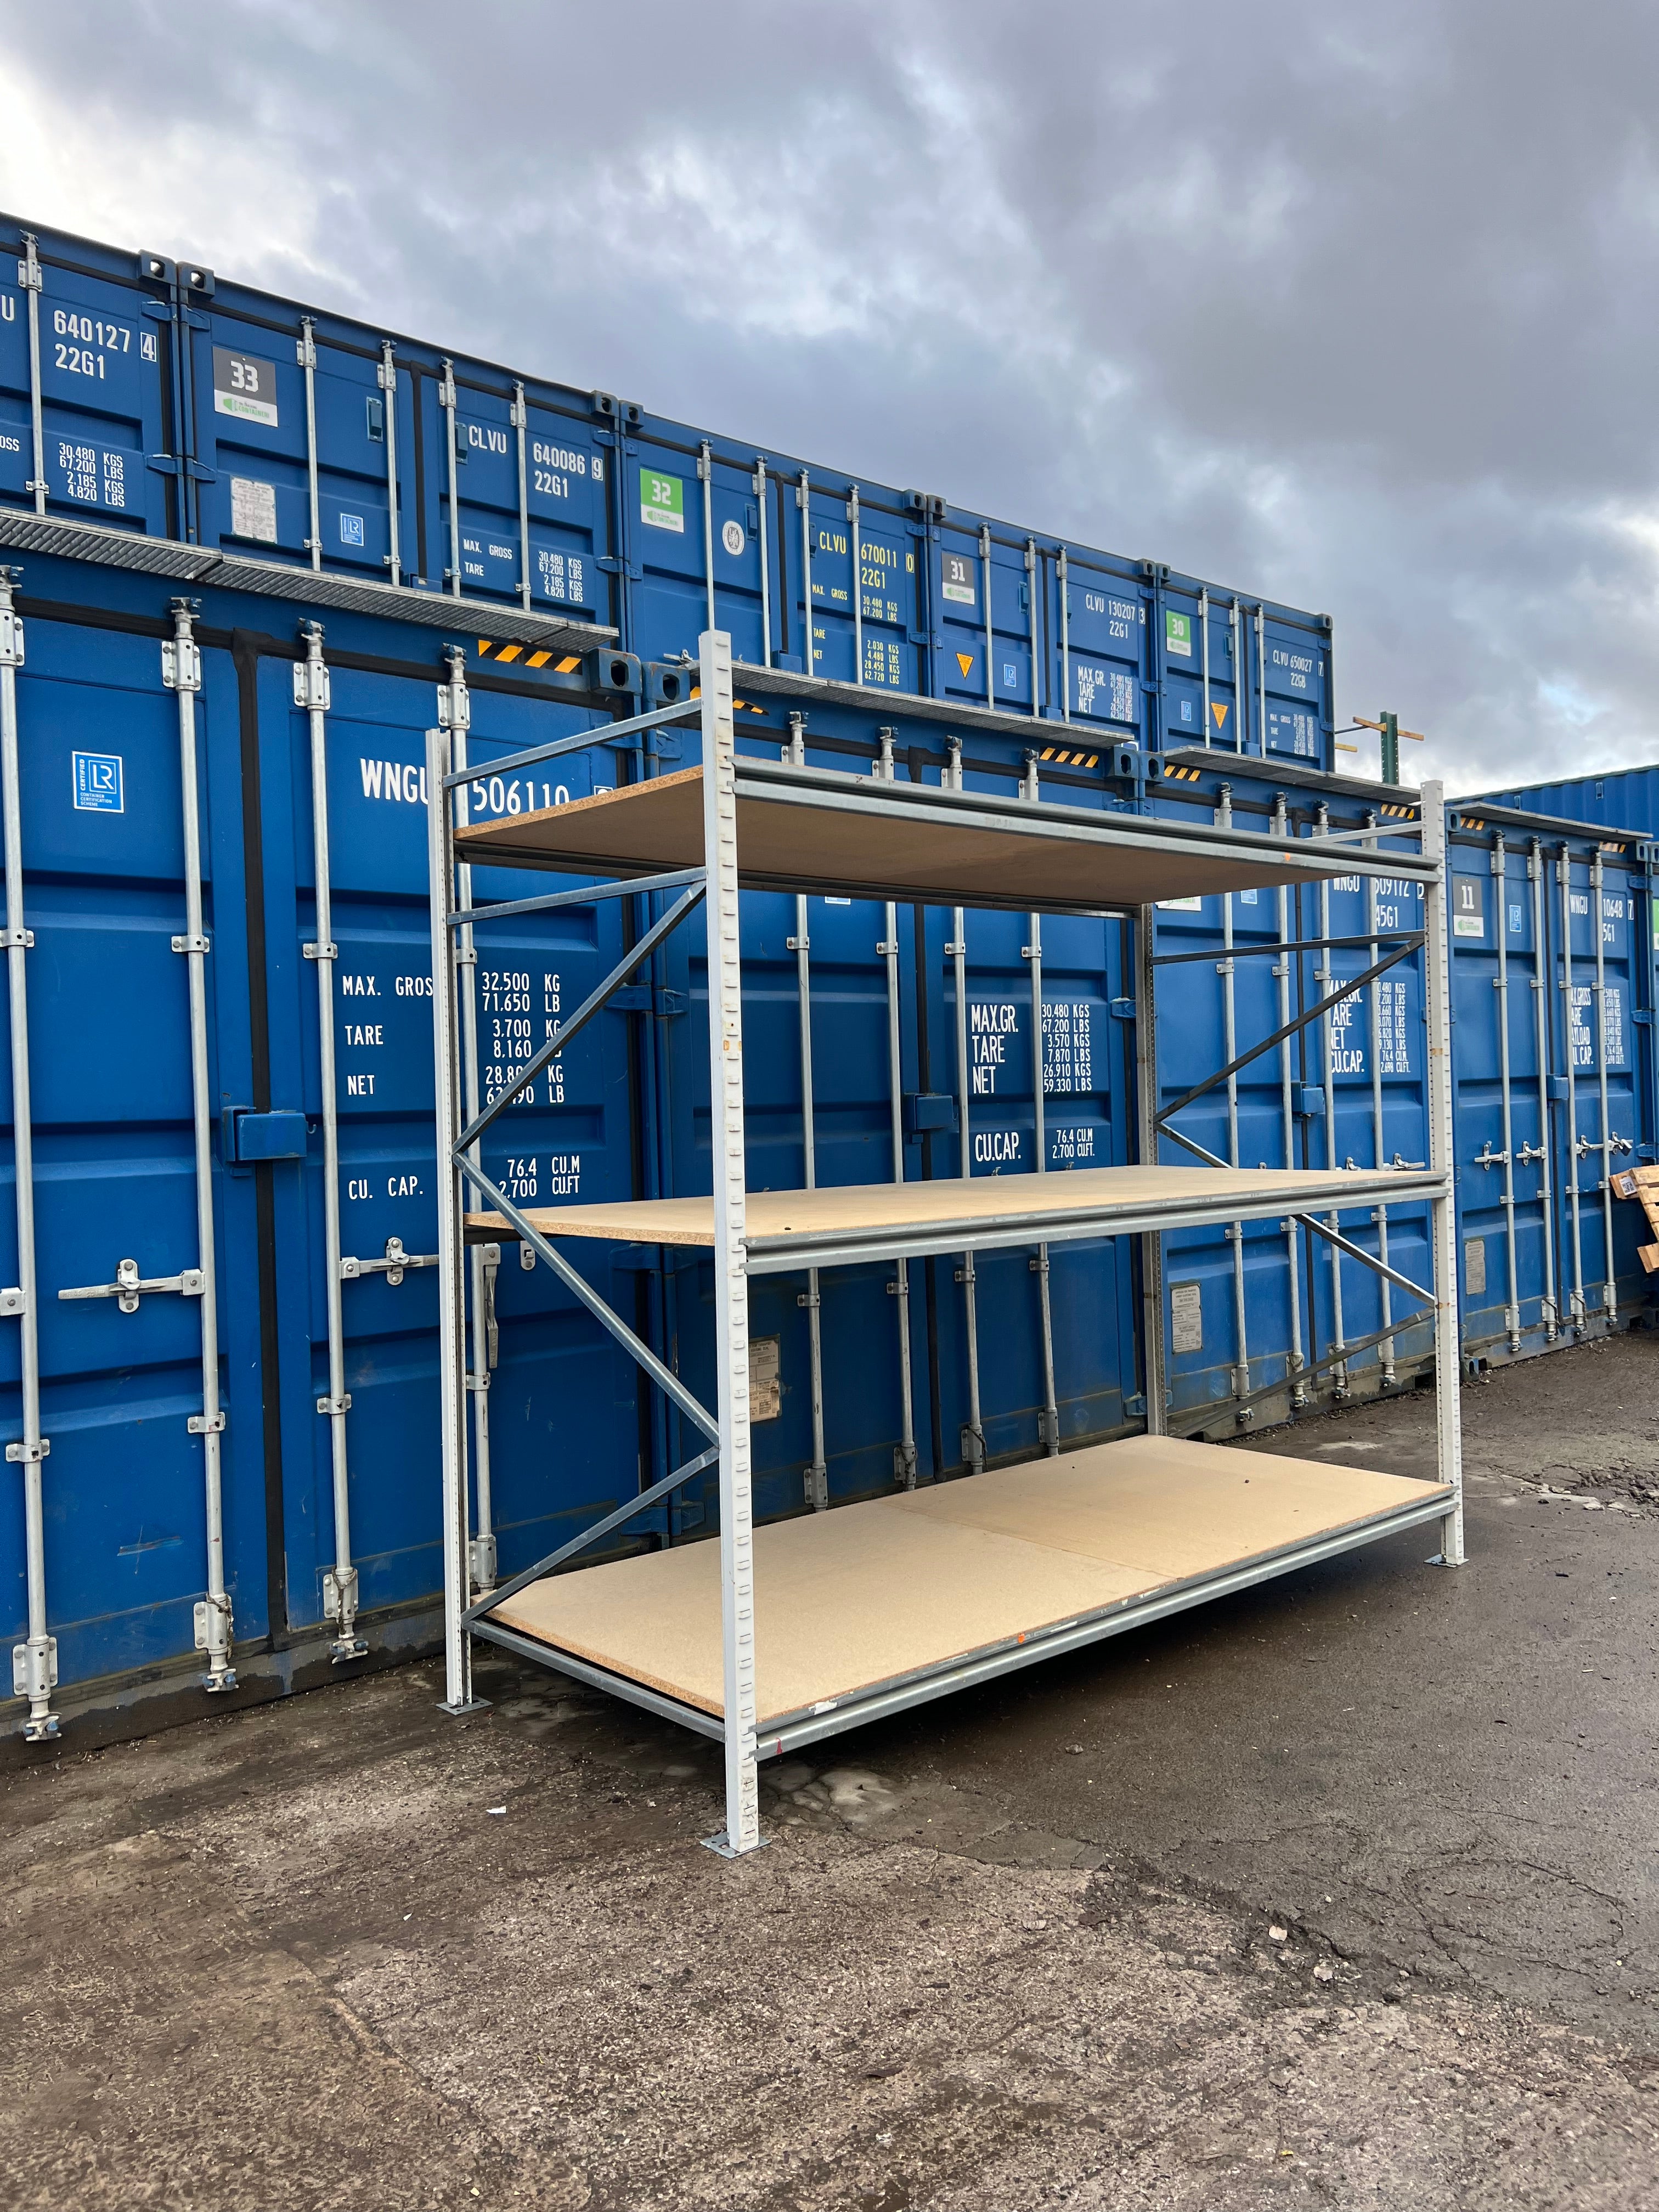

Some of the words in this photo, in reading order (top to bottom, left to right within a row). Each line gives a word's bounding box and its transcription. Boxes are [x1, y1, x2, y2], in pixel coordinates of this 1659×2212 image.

[54, 310, 130, 353] 640127
[142, 334, 155, 360] 4
[55, 343, 104, 379] 22G1
[230, 360, 258, 392] 33
[469, 426, 507, 454] CLVU
[59, 442, 95, 462] 30.480
[103, 452, 123, 468] KGS
[533, 443, 585, 475] 640086
[592, 458, 602, 479] 9
[59, 455, 96, 475] 67.200
[104, 465, 123, 480] LBS
[67, 471, 96, 489] 2.185
[104, 479, 124, 494] KGS
[534, 470, 568, 498] 22G1
[652, 479, 671, 505] 32
[67, 484, 97, 501] 4.820
[105, 492, 125, 507] LBS
[463, 539, 482, 553] MAX.
[489, 545, 512, 560] GROSS
[820, 532, 846, 554] CLVU
[539, 551, 563, 566] 30.480
[568, 557, 582, 570] KGS
[861, 543, 896, 568] 670011
[906, 554, 913, 572] 0
[465, 561, 484, 576] TARE
[539, 561, 564, 576] 67.200
[568, 568, 582, 580] LBS
[861, 567, 885, 589] 22G1
[951, 560, 965, 582] 31
[544, 574, 564, 588] 2.185
[569, 579, 583, 592] KGS
[812, 584, 825, 595] MAX.
[831, 588, 848, 600] GROSS
[544, 584, 565, 599] 4.820
[569, 590, 583, 602] LBS
[863, 595, 882, 608] 30.480
[887, 601, 898, 612] KGS
[1086, 594, 1104, 613] CLVU
[1109, 600, 1135, 621] 130207
[1139, 608, 1145, 624] 3
[863, 606, 882, 619] 67.200
[888, 612, 896, 622] LBS
[813, 628, 825, 639] TARE
[1109, 620, 1127, 639] 22G1
[1172, 618, 1184, 636] 30
[813, 649, 822, 659] NET
[867, 640, 883, 651] 2.030
[888, 644, 899, 654] KGS
[868, 650, 883, 662] 4.480
[889, 654, 898, 664] LBS
[1273, 650, 1288, 667] CLVU
[1290, 656, 1312, 673] 650027
[1319, 662, 1323, 676] 7
[865, 659, 884, 672] 28.450
[889, 664, 900, 675] KGS
[865, 670, 884, 682] 62.720
[889, 675, 899, 684] LBS
[1079, 681, 1095, 698] TARE
[1079, 696, 1092, 713] NET
[93, 764, 114, 789] LR
[1462, 885, 1474, 909] 11
[1570, 894, 1588, 915] WNGU
[1603, 898, 1623, 918] 10648
[1628, 900, 1633, 919] 7
[1376, 905, 1398, 928] 45G1
[1603, 923, 1615, 942] 5G1
[343, 976, 381, 995] MAX.
[396, 977, 432, 996] GROS
[482, 972, 529, 991] 32,500
[545, 974, 560, 992] KG
[1395, 983, 1405, 994] KGS
[482, 993, 530, 1012] 71,650
[545, 994, 560, 1012] LB
[1395, 995, 1405, 1005] LBS
[1042, 1004, 1069, 1018] 30.480
[1073, 1004, 1089, 1018] KGS
[1333, 1004, 1352, 1026] ARE
[1395, 1005, 1405, 1016] KGS
[1571, 1007, 1582, 1026] ARE
[493, 1019, 531, 1037] 3,700
[545, 1019, 561, 1037] KG
[1042, 1019, 1069, 1032] 67.200
[1073, 1019, 1090, 1032] LBS
[1395, 1017, 1405, 1028] LBS
[345, 1025, 383, 1045] TARE
[1047, 1034, 1070, 1047] 3.570
[1074, 1034, 1090, 1047] KGS
[1396, 1028, 1405, 1039] KGS
[494, 1040, 532, 1058] 8,160
[972, 1035, 1005, 1063] TARE
[1396, 1039, 1406, 1050] LBS
[1048, 1049, 1070, 1063] 7.870
[1074, 1048, 1091, 1062] LBS
[1383, 1050, 1393, 1061] 76.4
[1580, 1046, 1593, 1065] CAP.
[548, 1065, 563, 1083] KG
[1043, 1063, 1070, 1077] 26.910
[1075, 1063, 1091, 1076] KGS
[348, 1075, 374, 1095] NET
[973, 1066, 996, 1094] NET
[1044, 1078, 1071, 1092] 59.330
[1075, 1077, 1092, 1091] LBS
[549, 1085, 564, 1103] LB
[1056, 1129, 1074, 1143] 76.4
[1077, 1128, 1093, 1142] CU.M
[975, 1132, 1021, 1162] CU.CAP.
[1052, 1144, 1074, 1159] 2.700
[507, 1158, 537, 1178] 76.4
[551, 1155, 580, 1175] CU.M
[349, 1180, 373, 1200] CU.
[388, 1176, 424, 1197] CAP.
[552, 1175, 580, 1194] CU.FT
